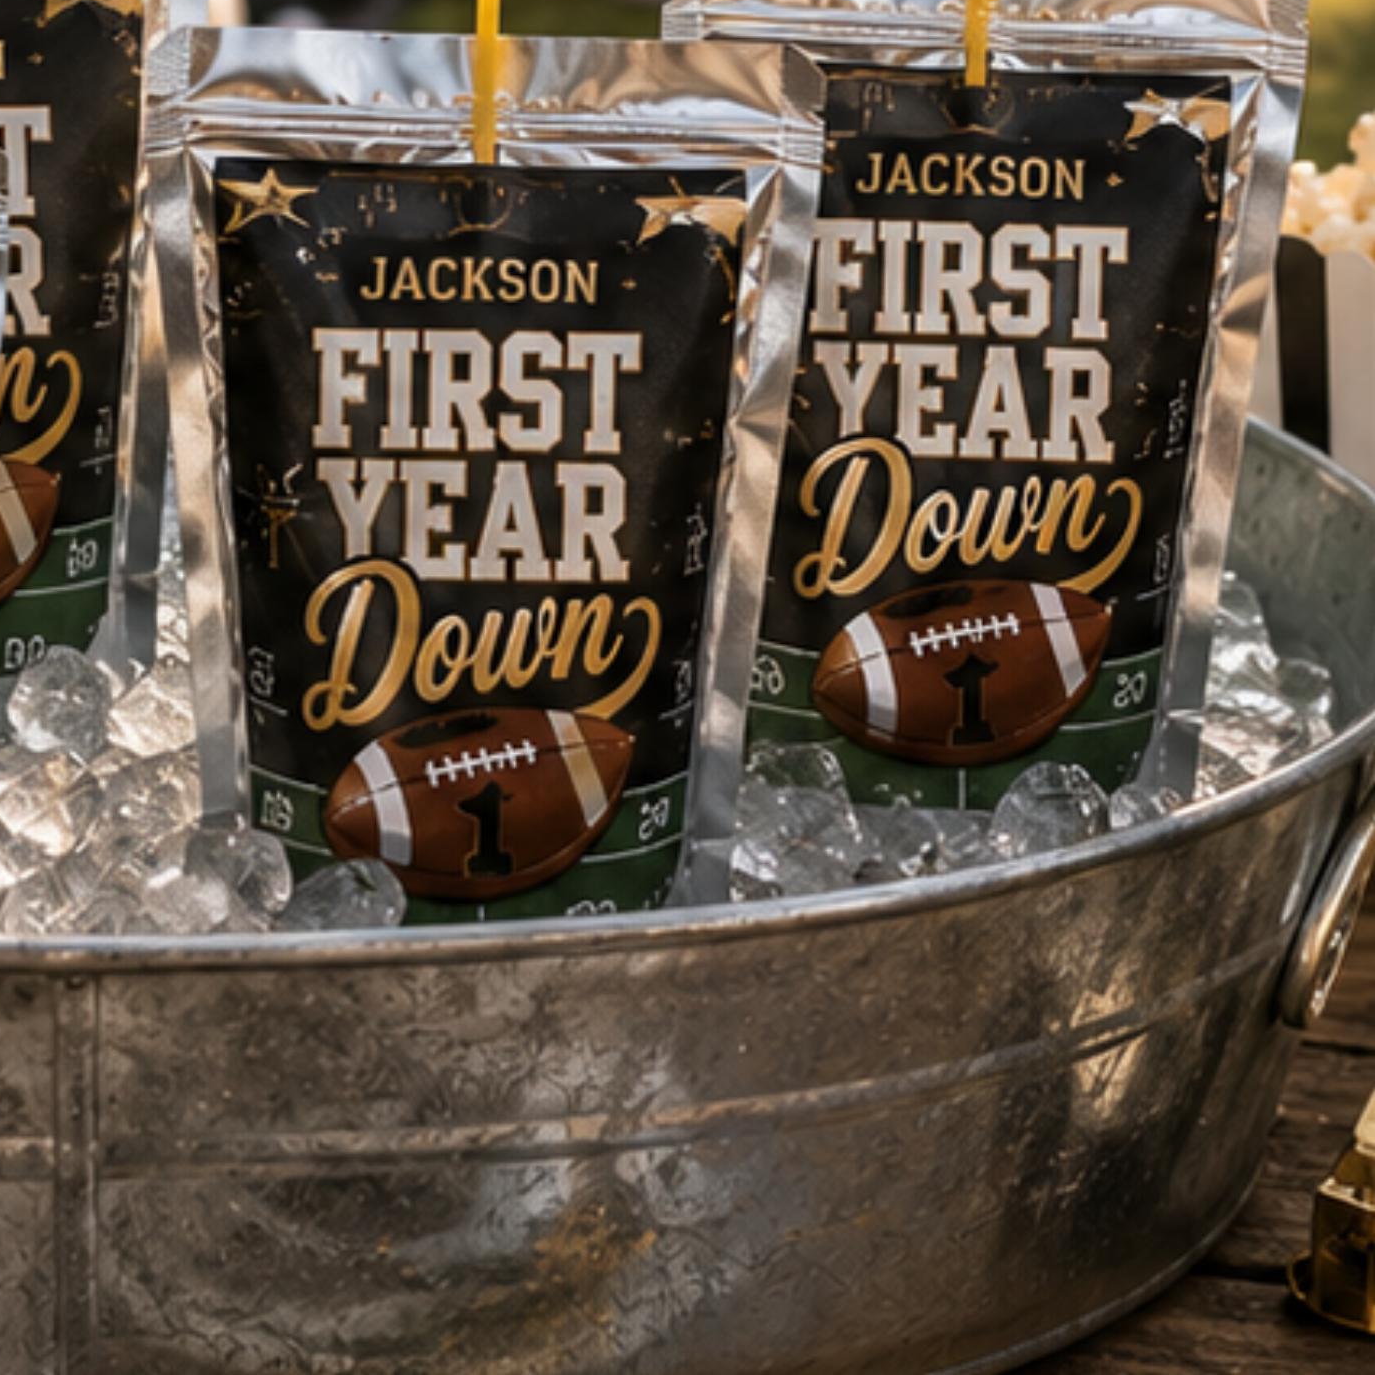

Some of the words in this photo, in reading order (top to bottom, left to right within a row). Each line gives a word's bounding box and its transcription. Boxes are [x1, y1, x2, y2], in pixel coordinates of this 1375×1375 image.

[855, 151, 1086, 201] JACKSON
[359, 255, 600, 305] JACKSON
[809, 218, 1130, 342] FIRST
[311, 326, 644, 456] FIRST
[812, 339, 1117, 466] YEAR
[316, 456, 632, 584] YEAR
[793, 436, 1144, 601] Down
[302, 558, 662, 732] Down
[456, 779, 515, 879] 1
